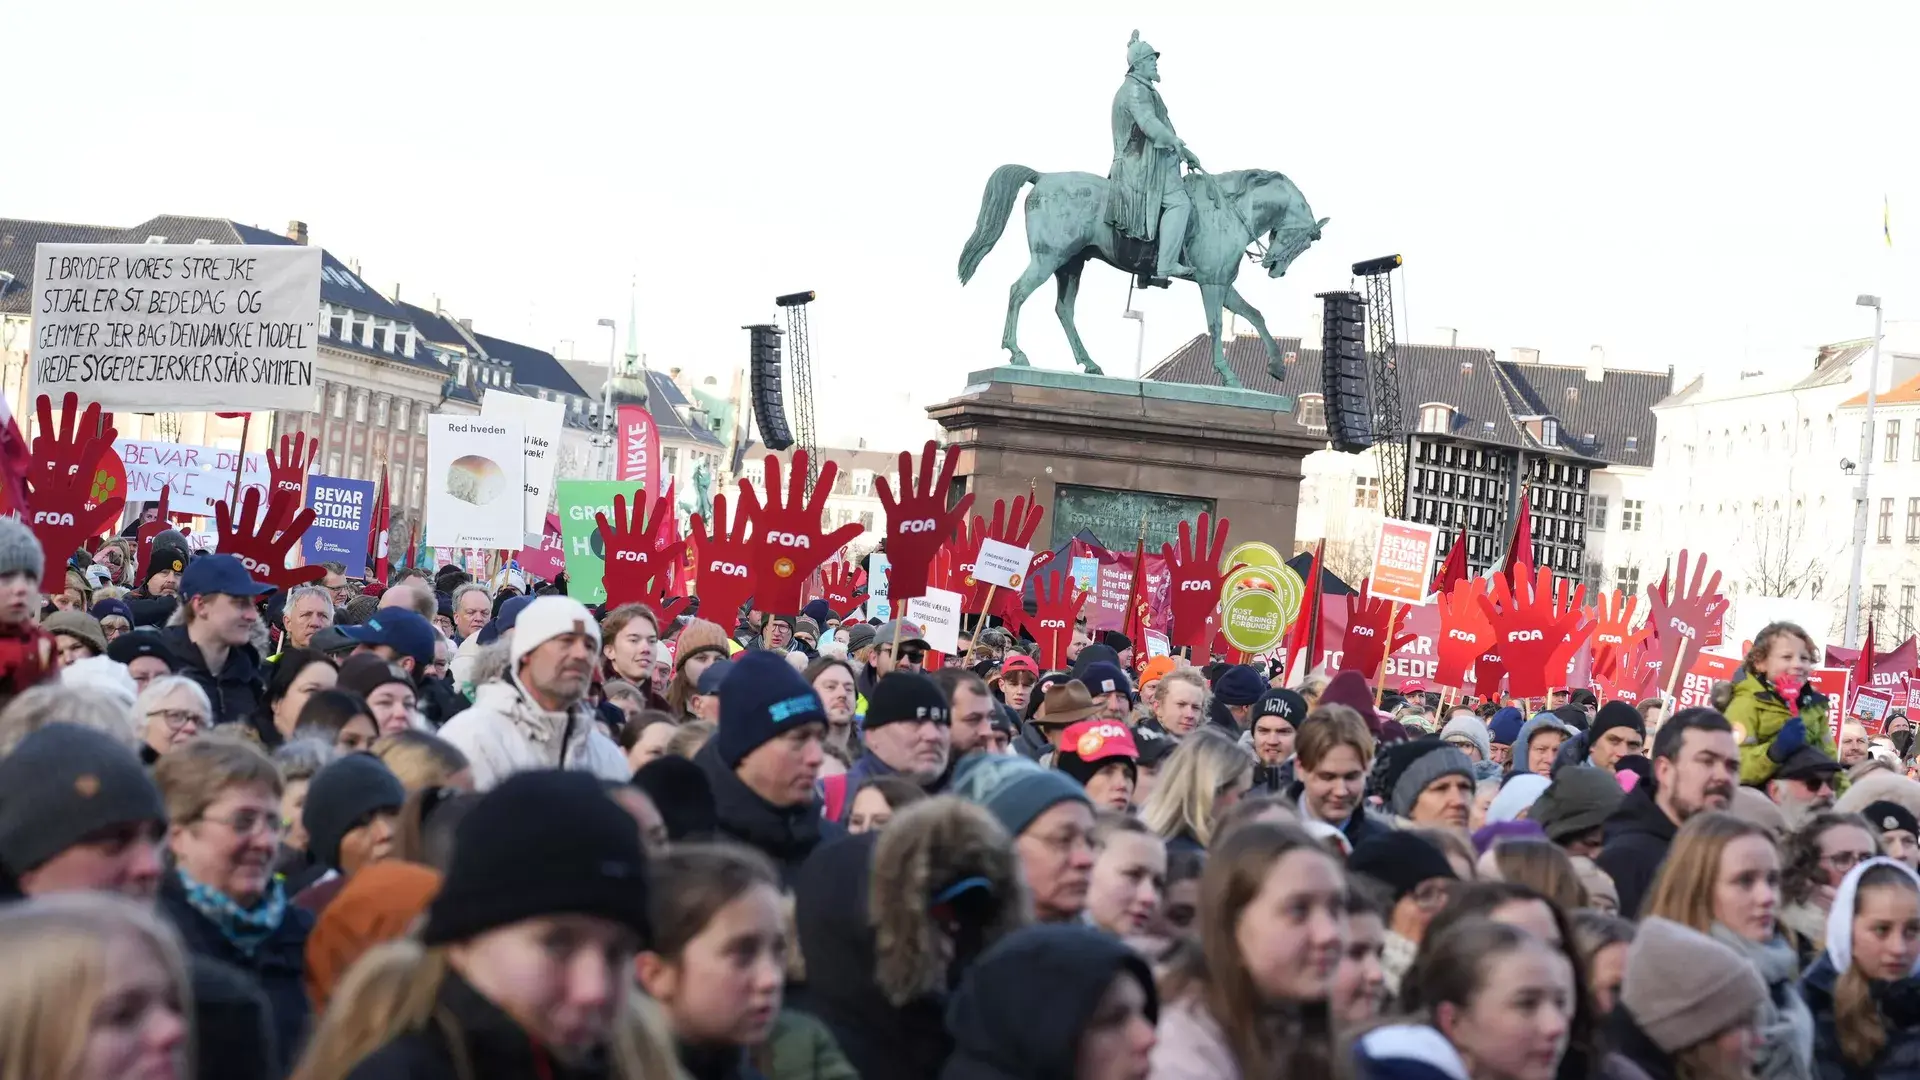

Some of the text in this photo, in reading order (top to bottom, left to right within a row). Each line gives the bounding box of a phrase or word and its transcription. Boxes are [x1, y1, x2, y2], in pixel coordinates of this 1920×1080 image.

[46, 256, 257, 280] I BRYDER VORES STREJKE
[42, 287, 262, 314] STJÆLER ST. BEDEDAG OG
[39, 323, 100, 350] GEMMER
[104, 323, 134, 348] JER
[137, 323, 167, 347] BAG
[200, 322, 254, 348] DANSKE
[38, 351, 312, 386] VREDE SYGEPLEJERSKER STÅR SAMMEN
[448, 423, 506, 434] Red hveden
[531, 436, 549, 448] ikke
[123, 444, 258, 473] BEVAR DEN
[126, 470, 199, 496] ANSKE
[278, 481, 300, 492] FOA
[524, 484, 540, 495] dag
[314, 486, 364, 505] BEVAR
[313, 502, 362, 520] STORE
[34, 511, 74, 527] FOA
[312, 517, 360, 531] BEDEDAG
[900, 518, 936, 534] FOA
[766, 530, 810, 548] FOA
[1383, 534, 1427, 554] BEVAR
[616, 550, 648, 562] FOA
[1033, 554, 1049, 566] FOA
[1381, 546, 1425, 565] STORE
[710, 560, 748, 578] FOA
[960, 564, 975, 572] FO
[1380, 557, 1423, 574] BEDEDAG
[1181, 580, 1211, 590] FOA
[829, 594, 846, 603] FOA
[1232, 608, 1252, 616] KOST
[1040, 618, 1065, 628] FOA
[1231, 614, 1277, 625] ERNÆRINGS
[1231, 620, 1277, 631] FORBUNDET
[1352, 625, 1374, 637] FOA
[1670, 617, 1696, 639] FOA
[1449, 628, 1476, 643] FOA
[1508, 630, 1543, 642] FOA
[1598, 634, 1622, 643] FOA
[1684, 672, 1713, 689] BEV
[1872, 672, 1909, 685] EDAG
[1618, 690, 1636, 700] FOA
[1680, 688, 1711, 706] STO
